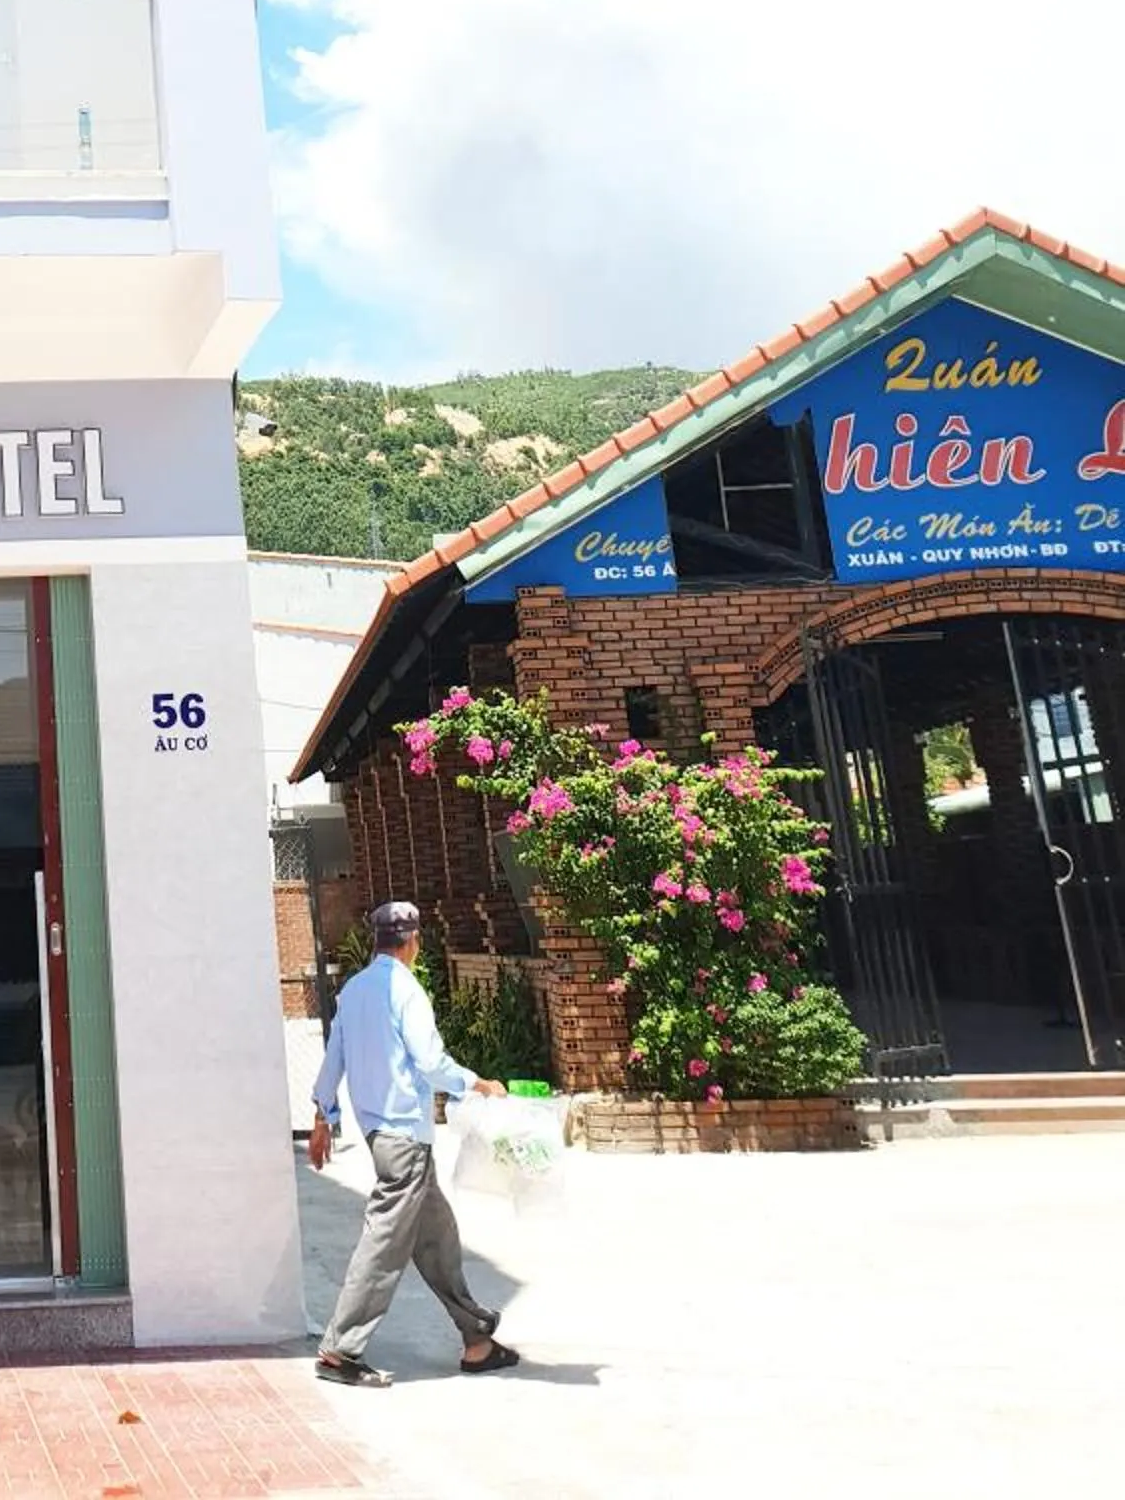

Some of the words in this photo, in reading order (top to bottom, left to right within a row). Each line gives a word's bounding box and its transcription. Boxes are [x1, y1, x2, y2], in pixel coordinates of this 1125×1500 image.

[885, 338, 1042, 393] Quán
[846, 515, 907, 547] Các
[919, 511, 996, 539] Món
[922, 548, 964, 563] QUY
[632, 564, 656, 578] 56
[152, 692, 206, 729] 56
[154, 735, 178, 752] ÂU
[184, 733, 208, 751] CƠ
